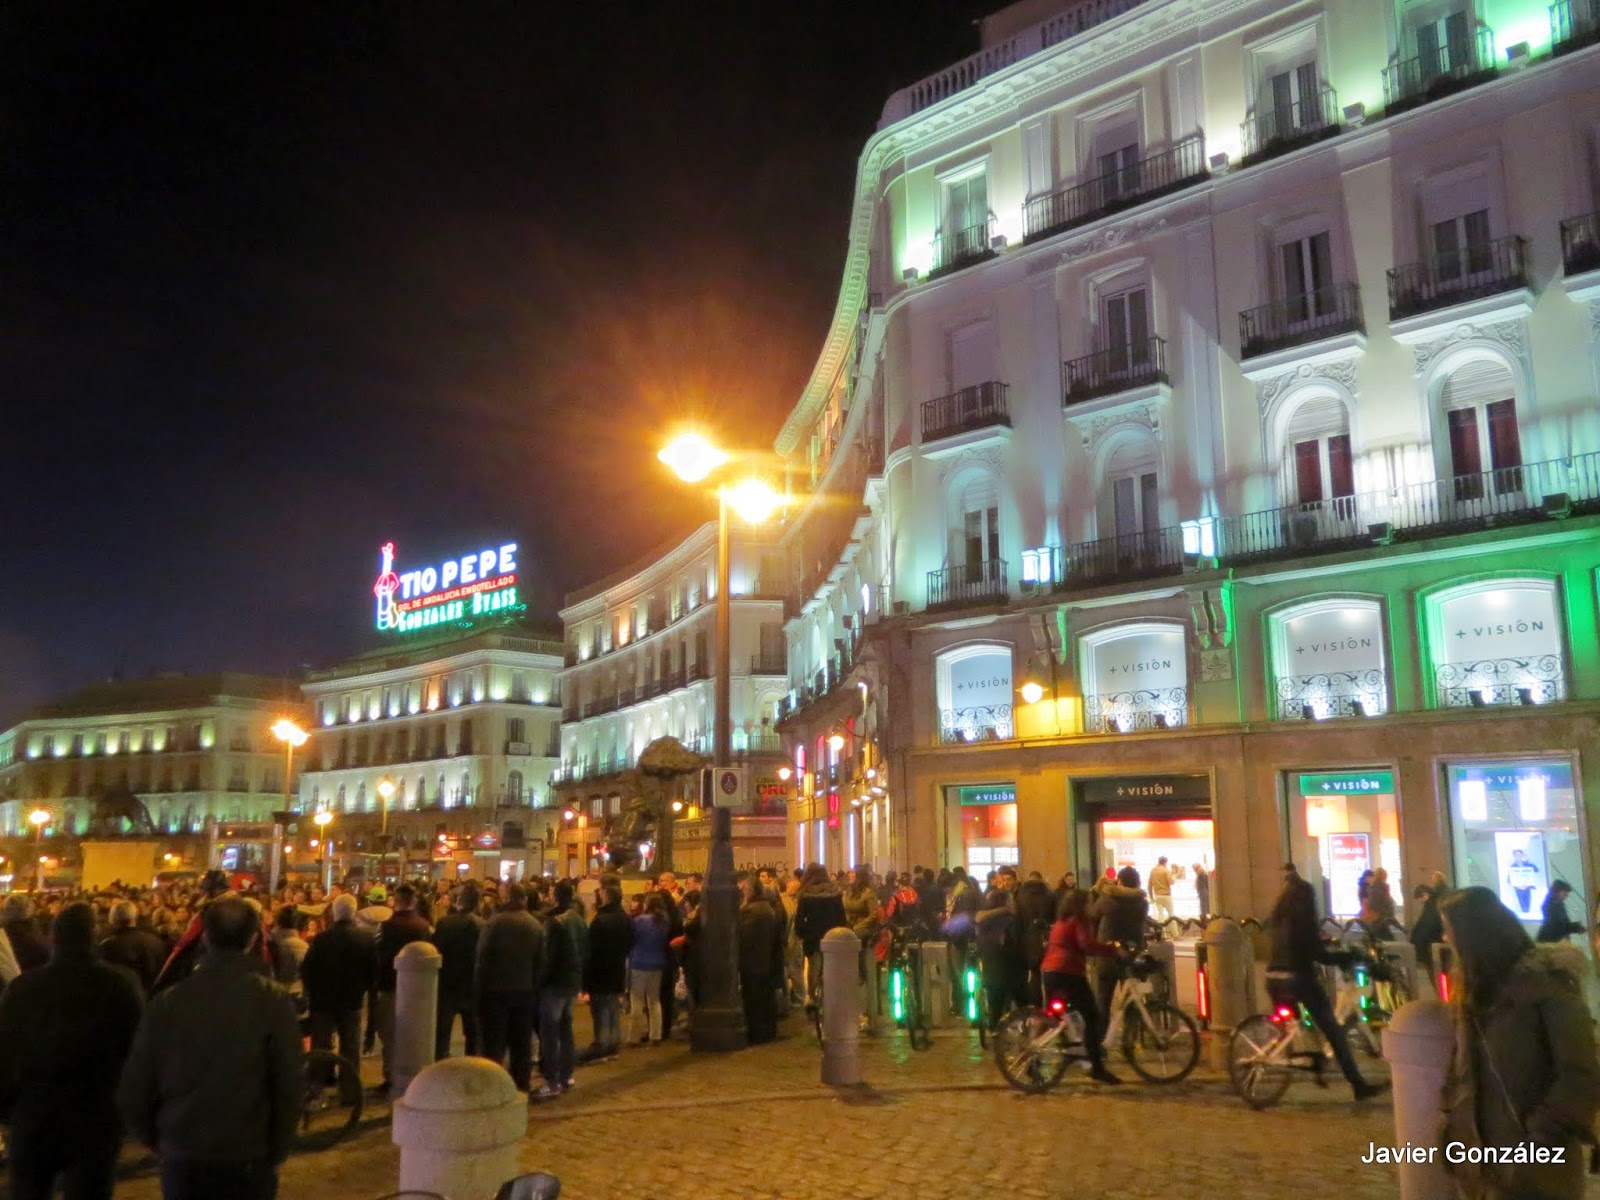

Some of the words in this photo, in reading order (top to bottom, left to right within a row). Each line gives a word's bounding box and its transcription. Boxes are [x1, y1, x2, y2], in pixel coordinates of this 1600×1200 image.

[400, 567, 437, 599] TIO
[442, 543, 517, 588] PEPE
[398, 602, 412, 612] SOL
[412, 599, 422, 608] DE
[1473, 619, 1544, 637] VISIÓN
[1311, 637, 1371, 652] VISIÓN
[1122, 659, 1171, 673] VISIÓN
[968, 676, 1009, 689] VISIÓN
[1128, 783, 1173, 796] VISIÓN
[1333, 778, 1380, 790] VISIÓN
[983, 791, 1015, 801] VISIÓN
